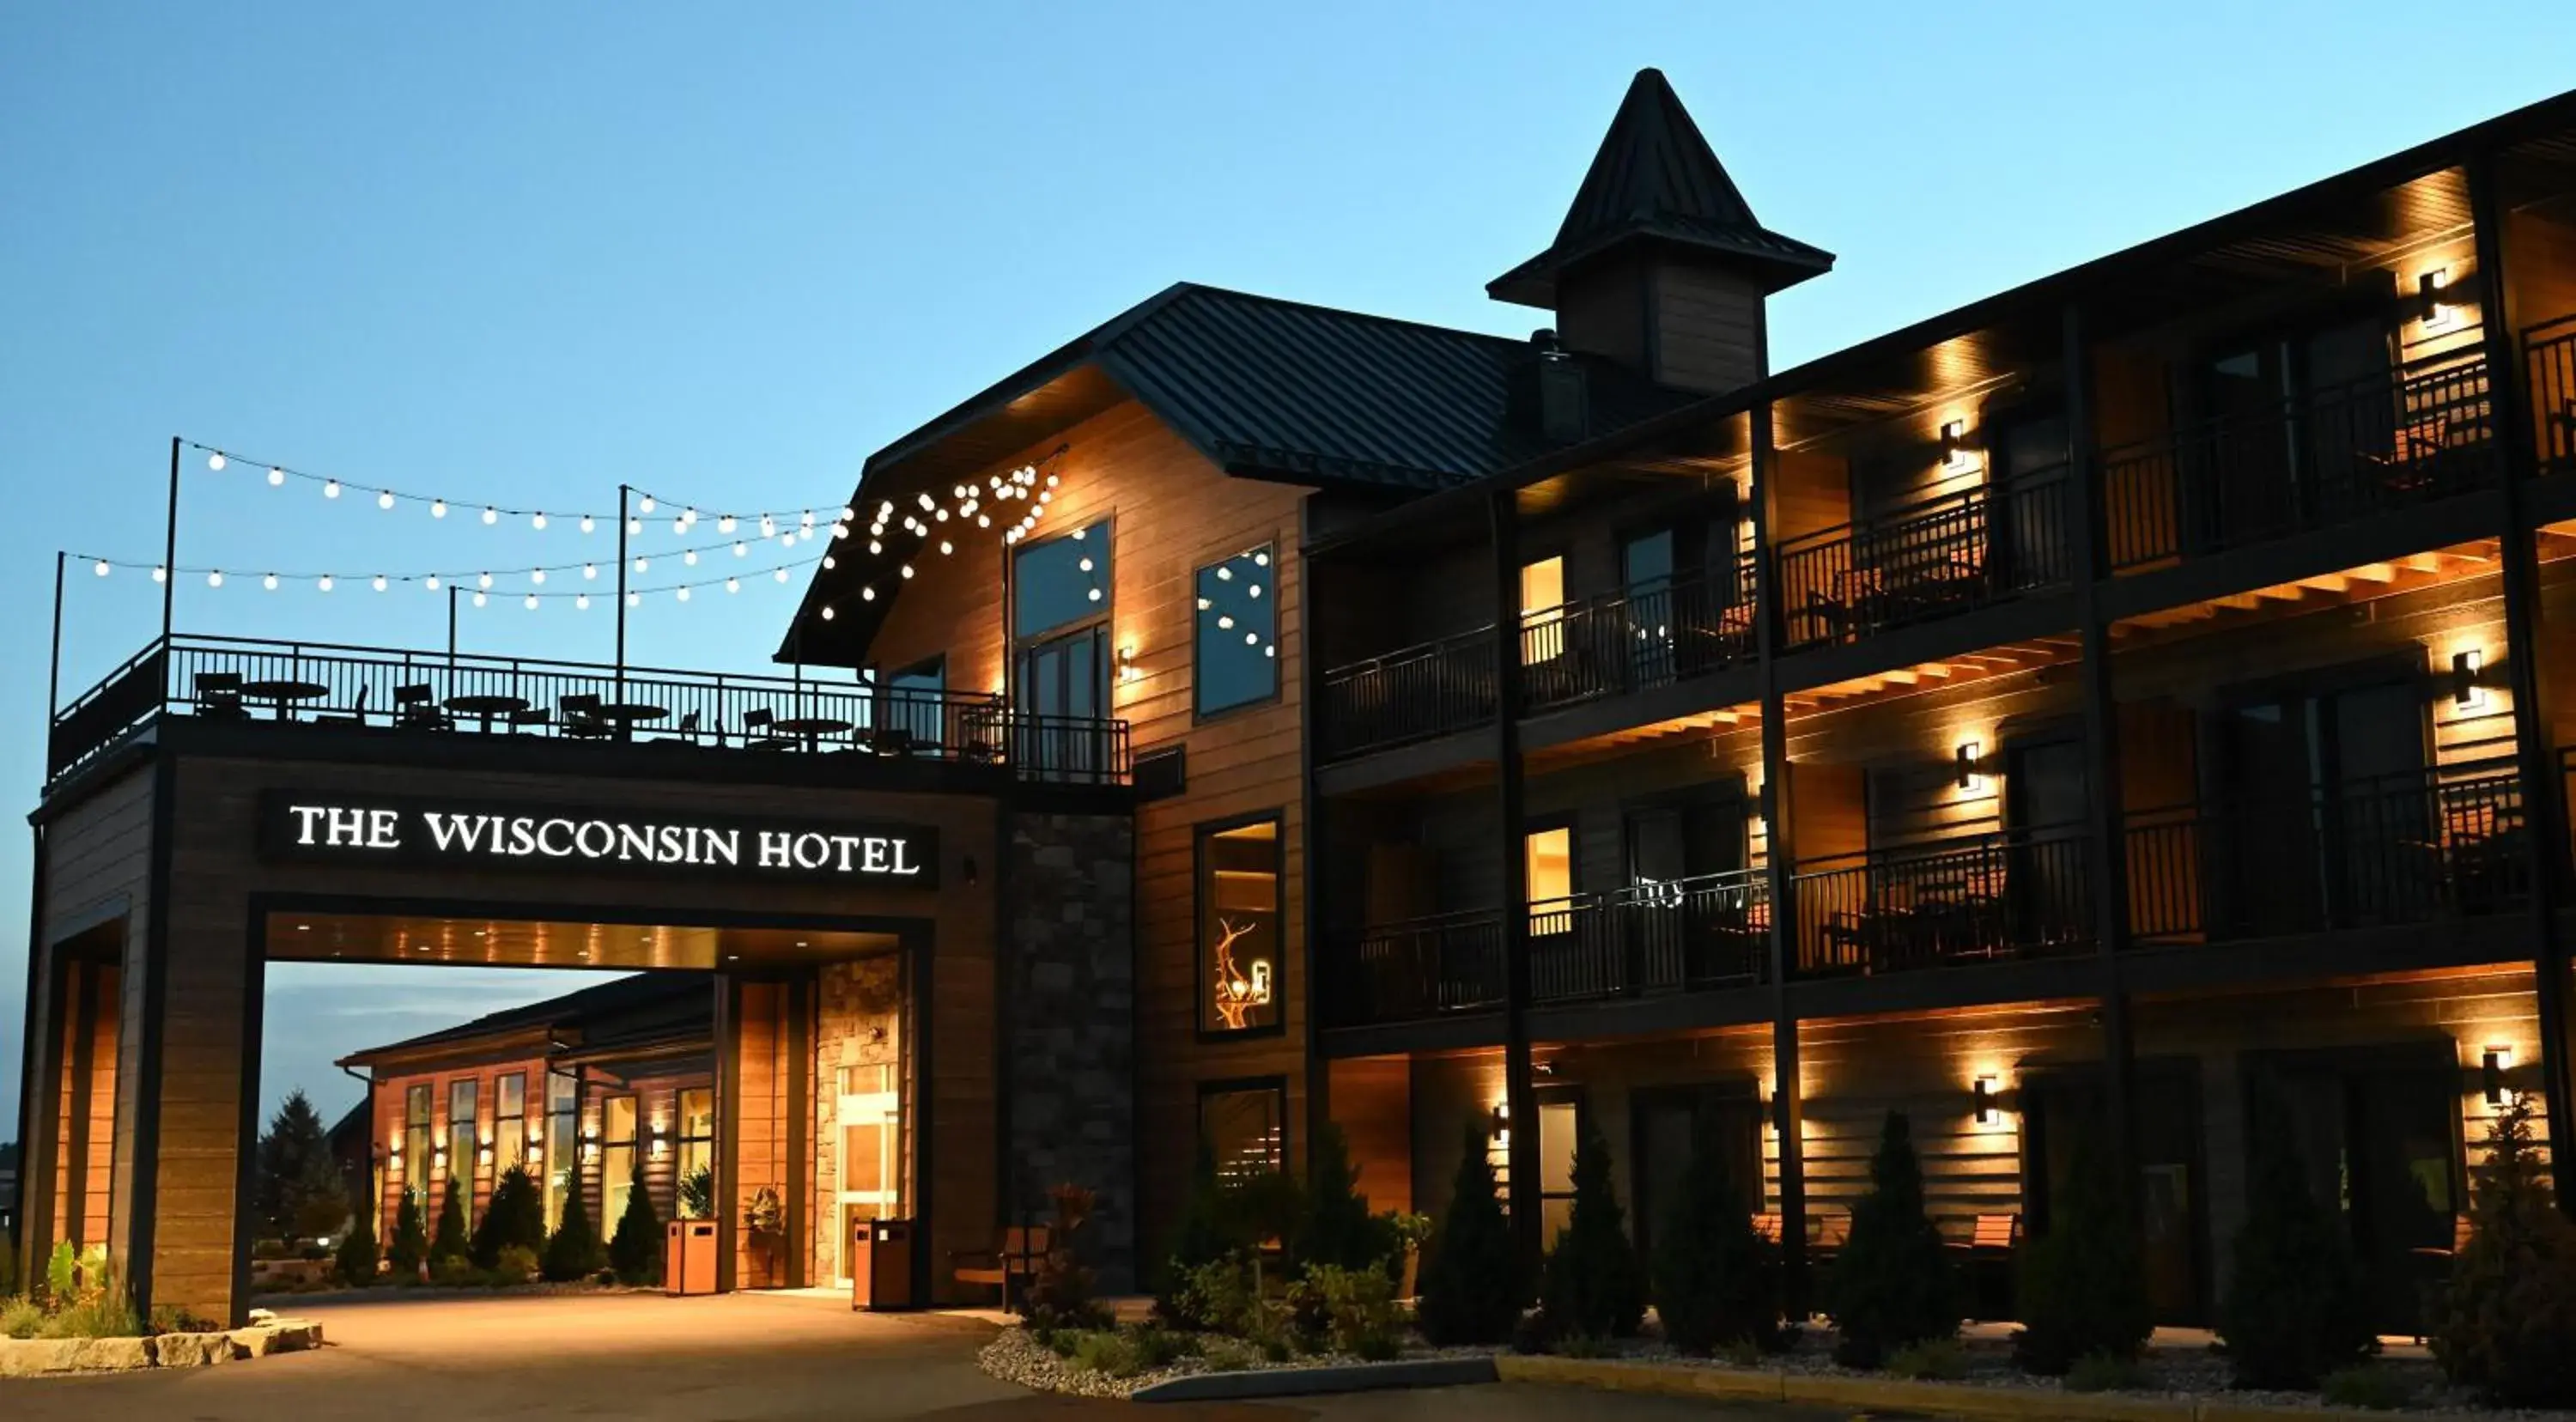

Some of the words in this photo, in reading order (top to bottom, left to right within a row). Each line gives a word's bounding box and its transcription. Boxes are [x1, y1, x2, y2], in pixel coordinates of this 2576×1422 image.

[289, 805, 402, 849] THE
[422, 811, 741, 866] WISCONSIN
[757, 830, 920, 876] HOTEL
